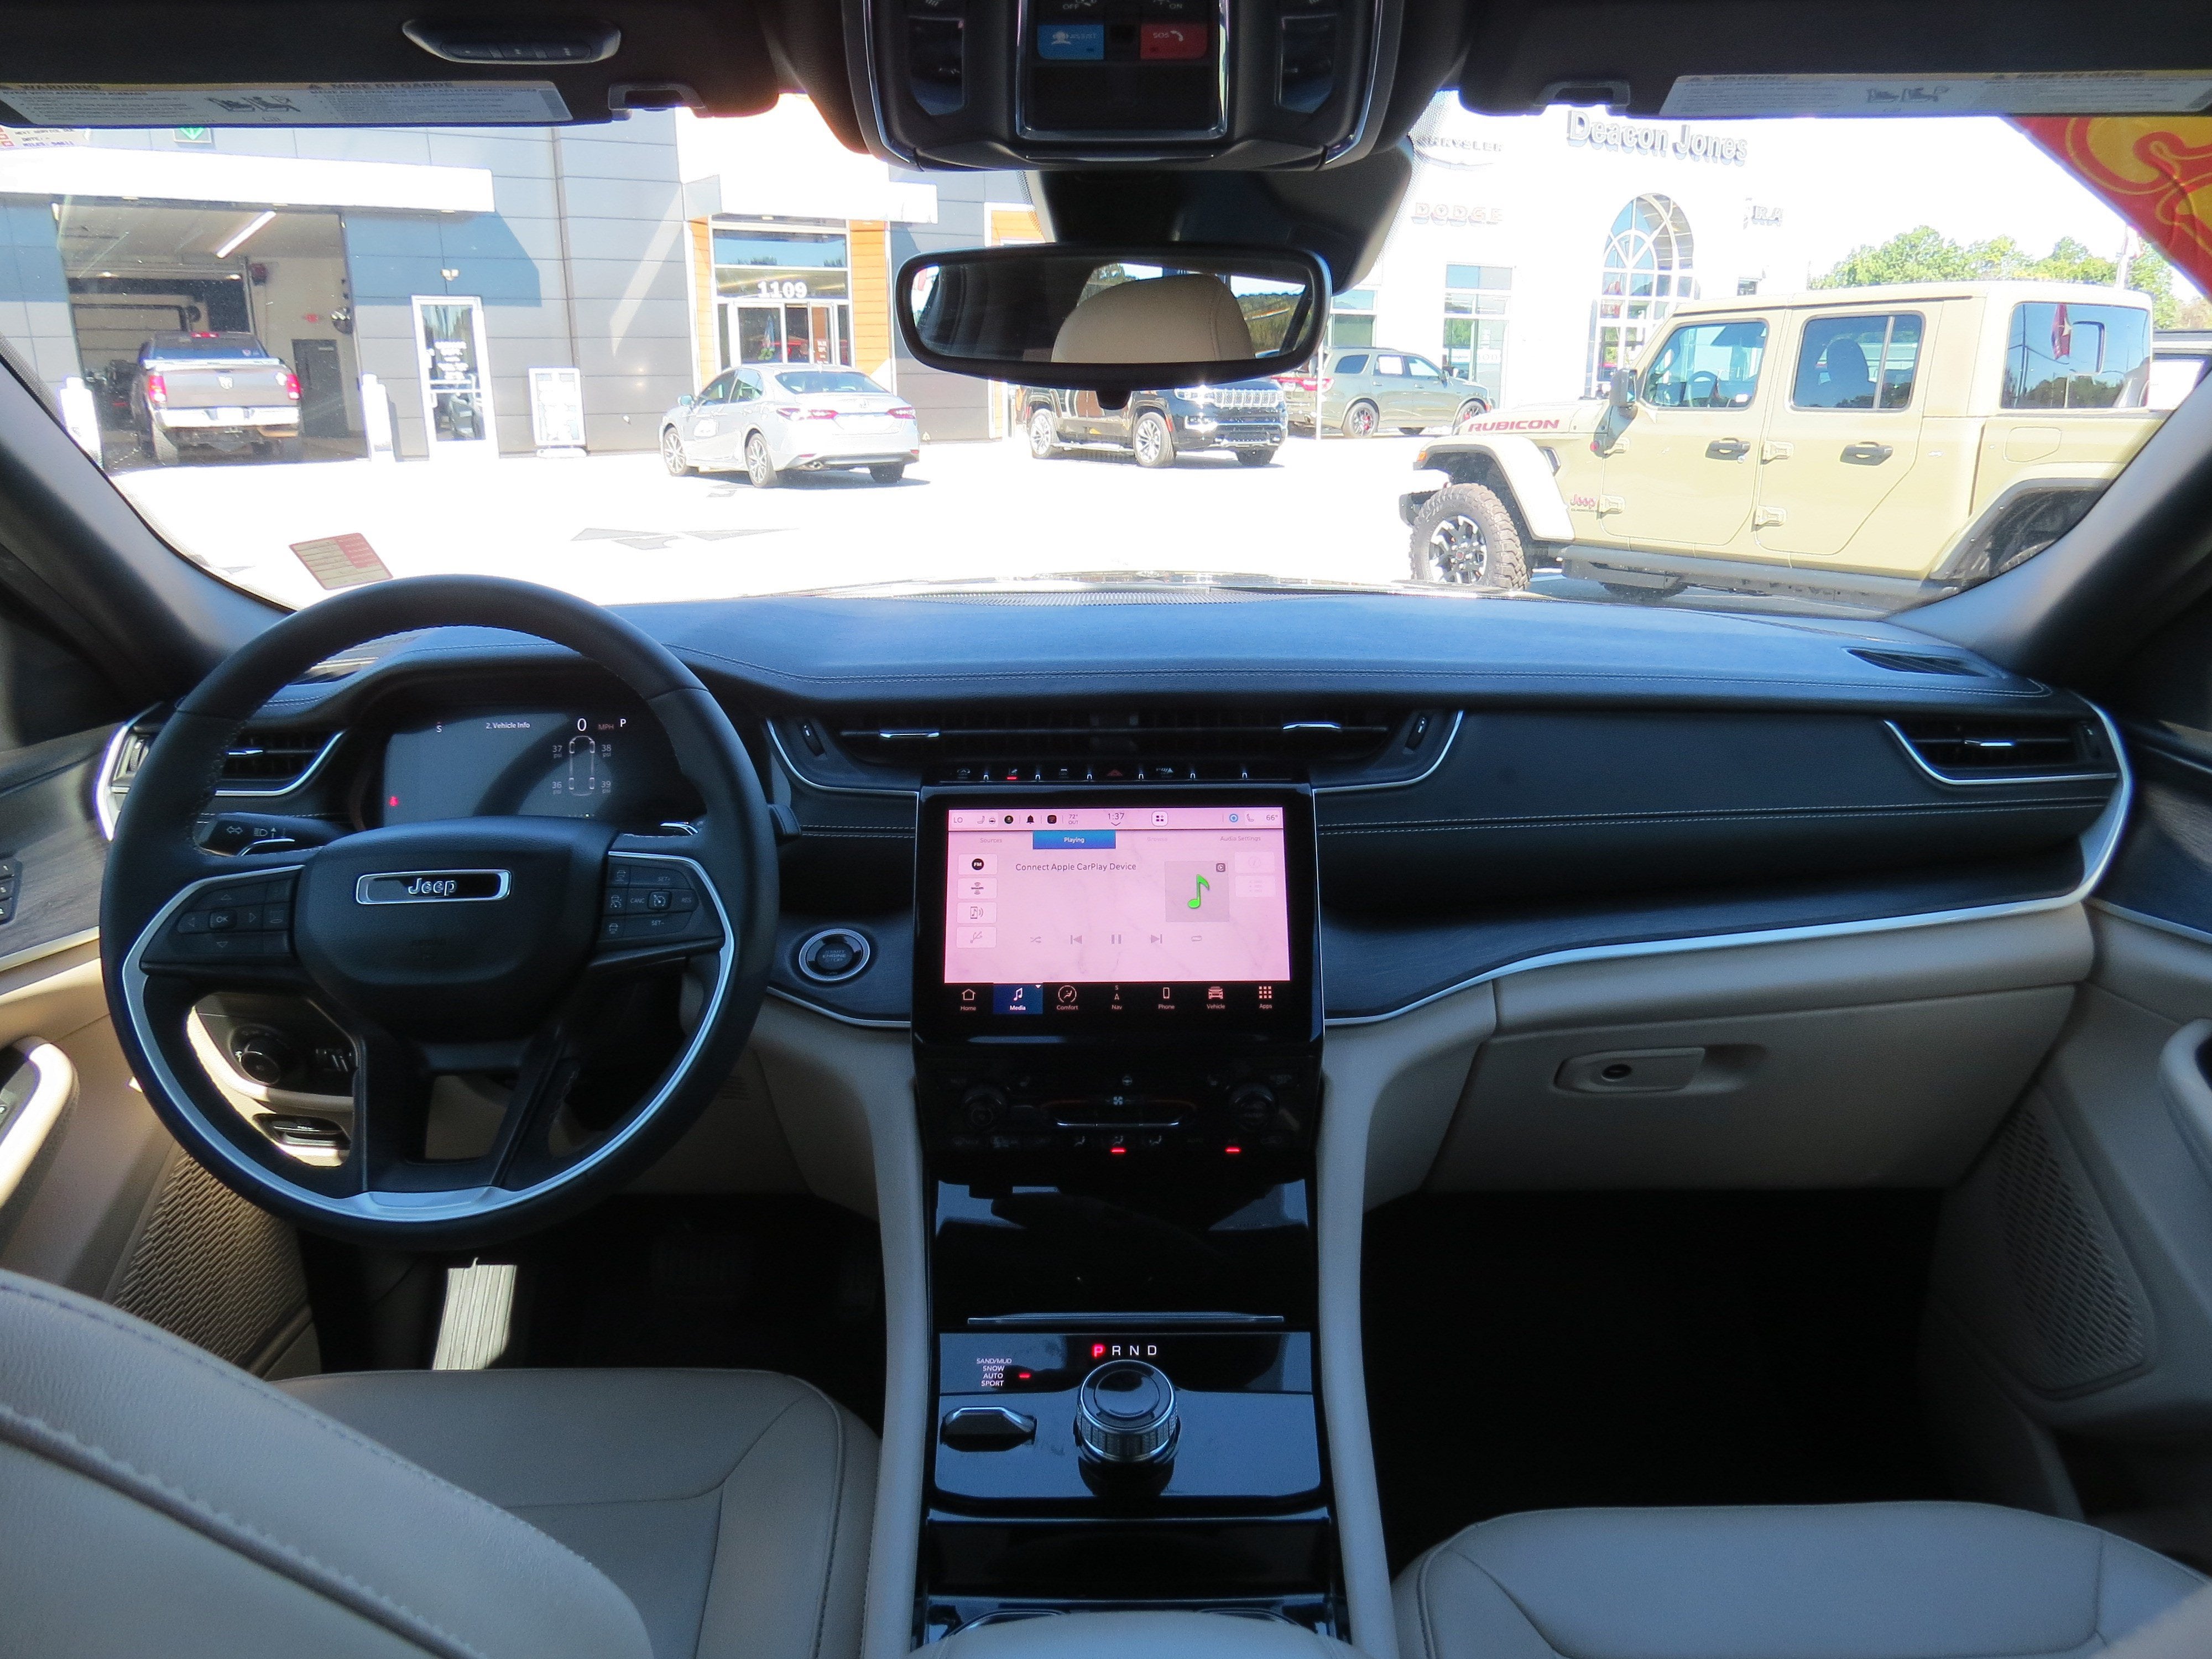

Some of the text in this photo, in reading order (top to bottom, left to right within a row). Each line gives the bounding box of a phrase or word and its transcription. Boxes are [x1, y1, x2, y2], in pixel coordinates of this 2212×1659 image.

[1567, 110, 1747, 162] Deacon Jones
[1414, 202, 1503, 222] DODGE
[758, 281, 807, 299] 1109
[1468, 419, 1560, 432] RUBICON
[1570, 494, 1595, 509] Jeep
[577, 718, 587, 731] 0
[620, 718, 627, 727] P
[1051, 863, 1074, 872] Apple
[1077, 863, 1108, 872] CarPlay
[1109, 862, 1137, 870] Device
[408, 877, 456, 896] Jeep
[1093, 1345, 1157, 1358] P R N D
